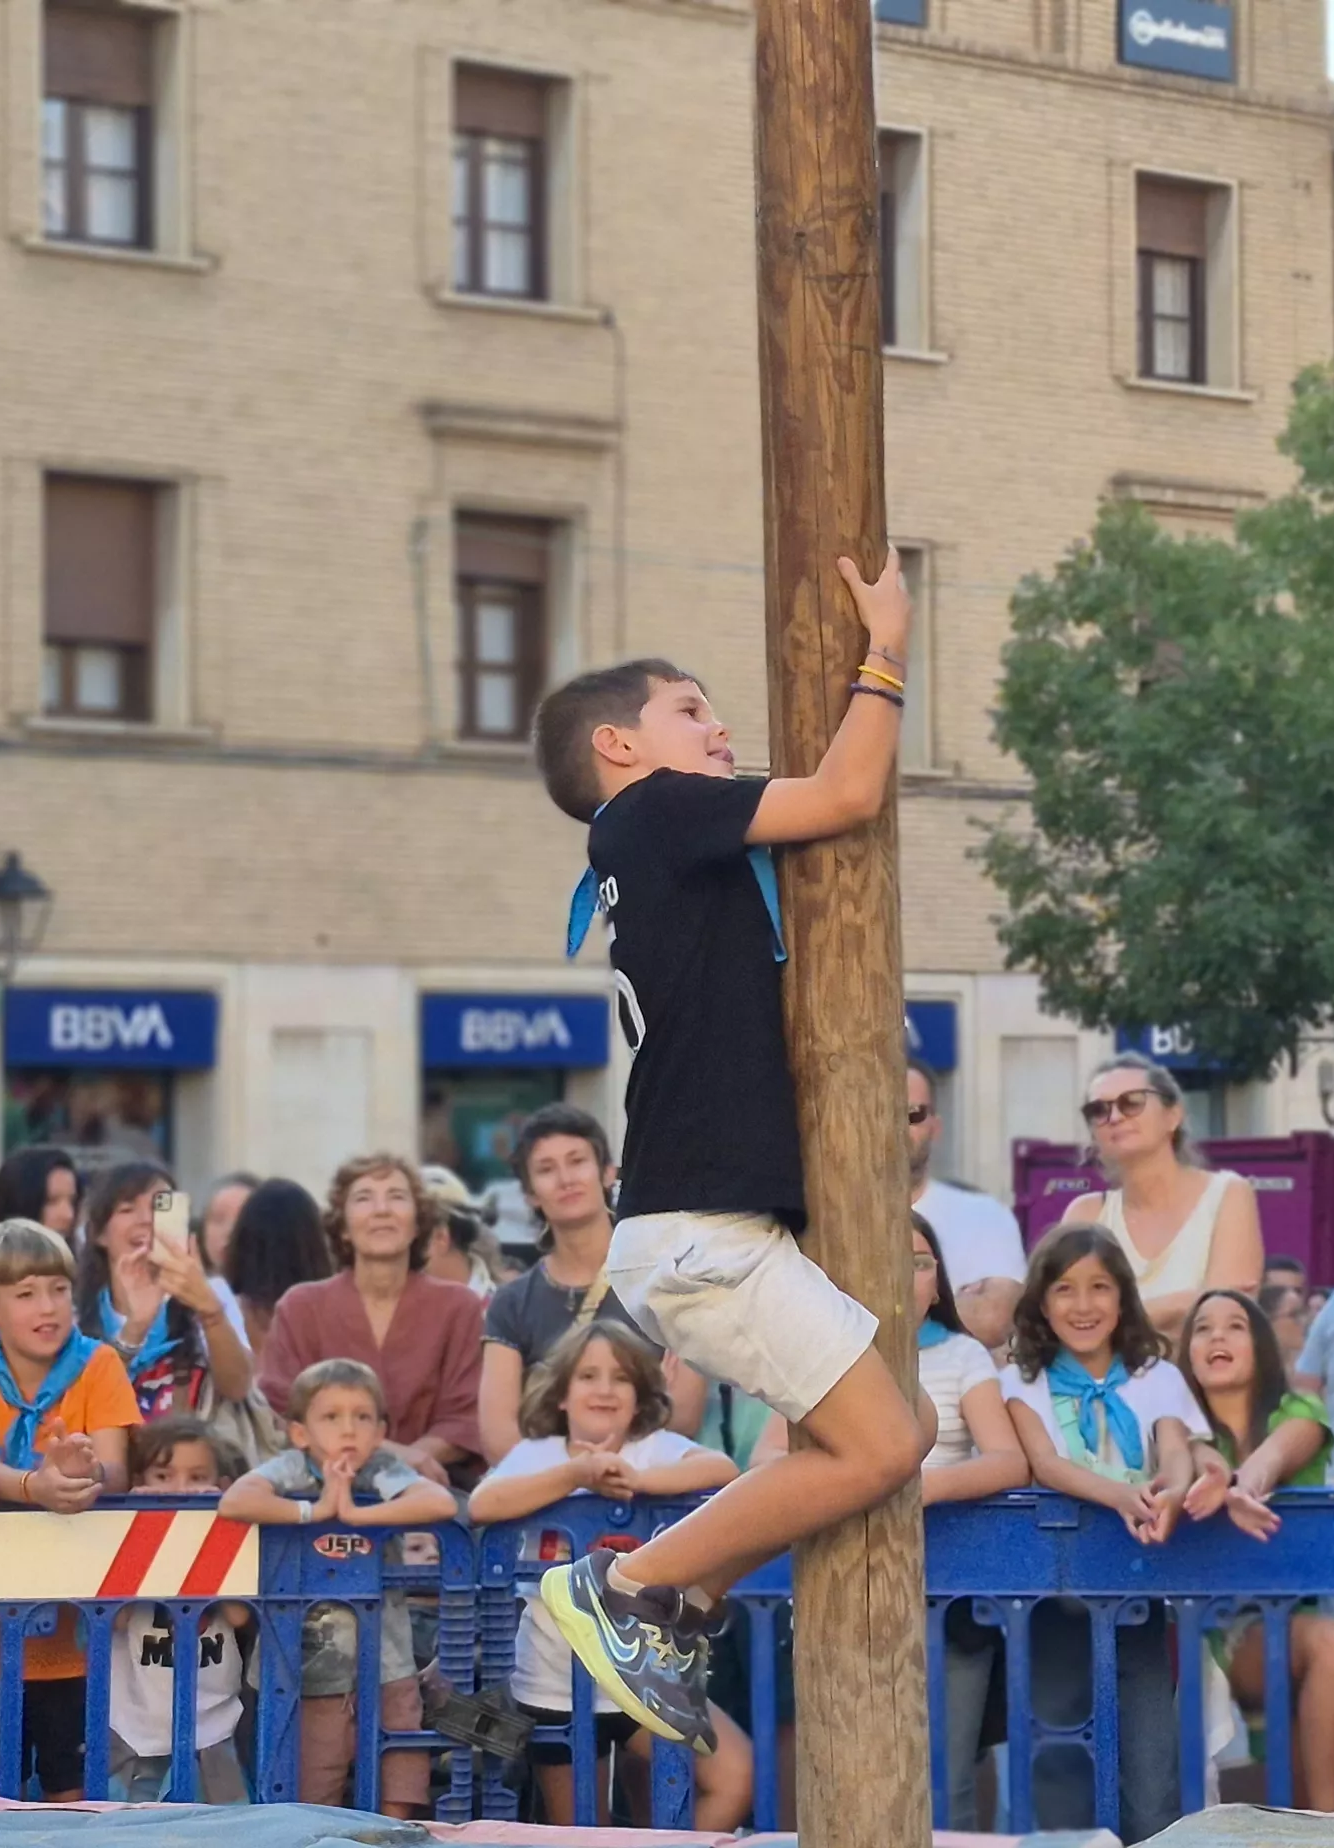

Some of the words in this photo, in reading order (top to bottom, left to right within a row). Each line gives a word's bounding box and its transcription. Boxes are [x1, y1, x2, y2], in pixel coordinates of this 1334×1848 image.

[50, 1001, 174, 1051] BBVA
[461, 1006, 571, 1052] BBVA
[322, 1536, 364, 1553] JSP
[141, 1632, 225, 1668] MN
